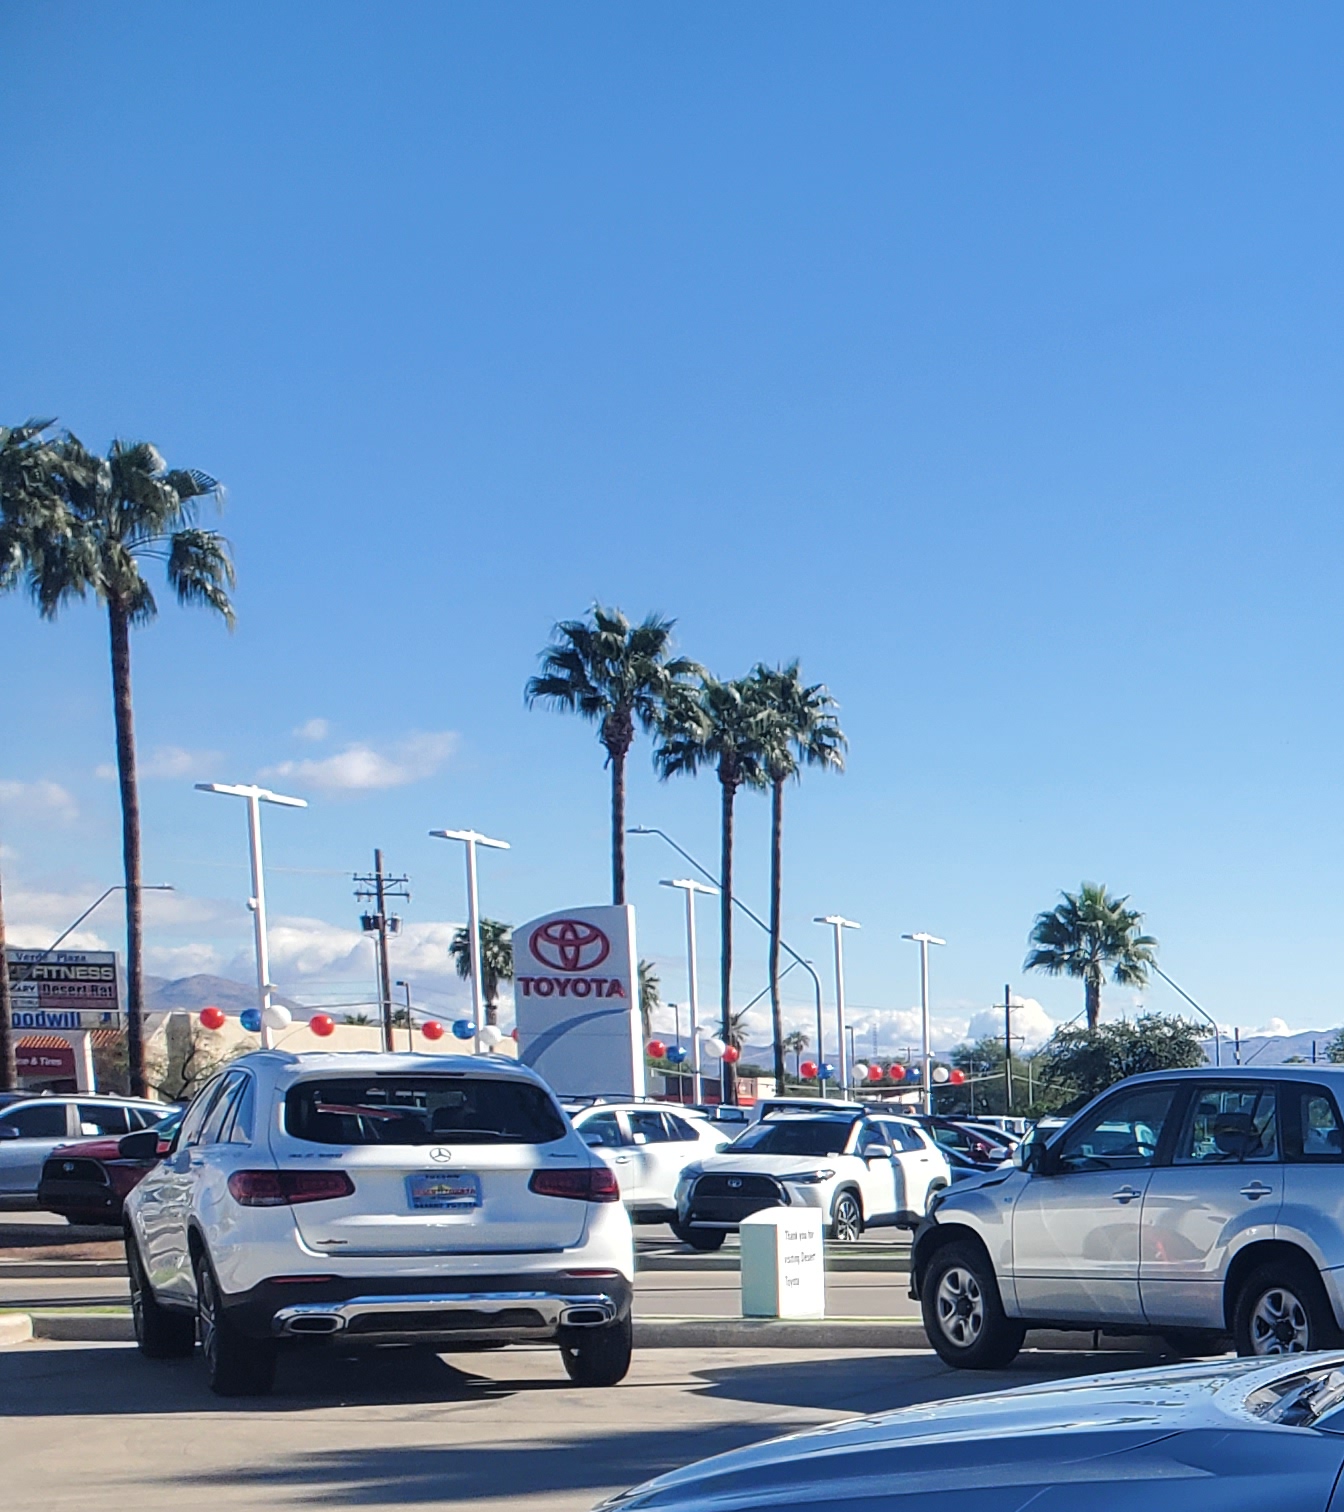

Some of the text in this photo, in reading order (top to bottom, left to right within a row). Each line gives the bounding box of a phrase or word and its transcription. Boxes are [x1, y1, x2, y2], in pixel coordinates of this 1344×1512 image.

[32, 965, 114, 980] FITNESS
[43, 984, 86, 996] Desert
[90, 985, 112, 997] Rat
[517, 977, 626, 998] TOYOTA
[12, 1010, 80, 1028] oodwill
